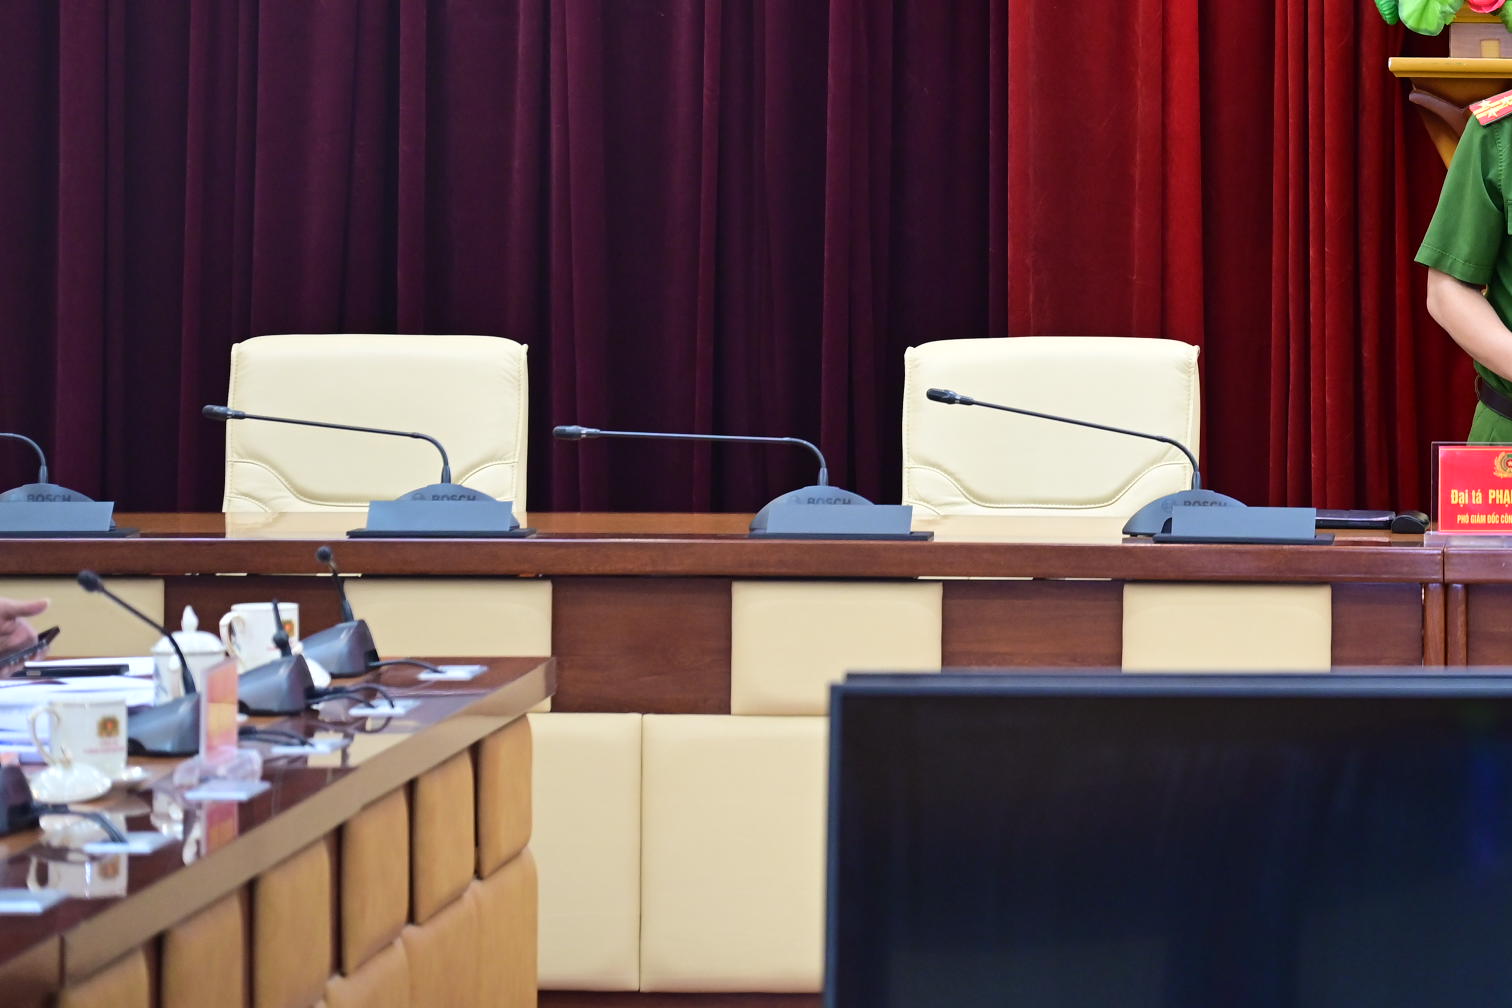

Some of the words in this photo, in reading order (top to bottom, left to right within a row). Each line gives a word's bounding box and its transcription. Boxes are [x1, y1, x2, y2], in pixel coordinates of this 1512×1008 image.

[1451, 489, 1469, 507] Đại
[1472, 489, 1482, 504] tá
[1457, 512, 1470, 524] PHÓ
[1470, 513, 1486, 524] GIÁM
[1487, 512, 1499, 524] ĐỐC
